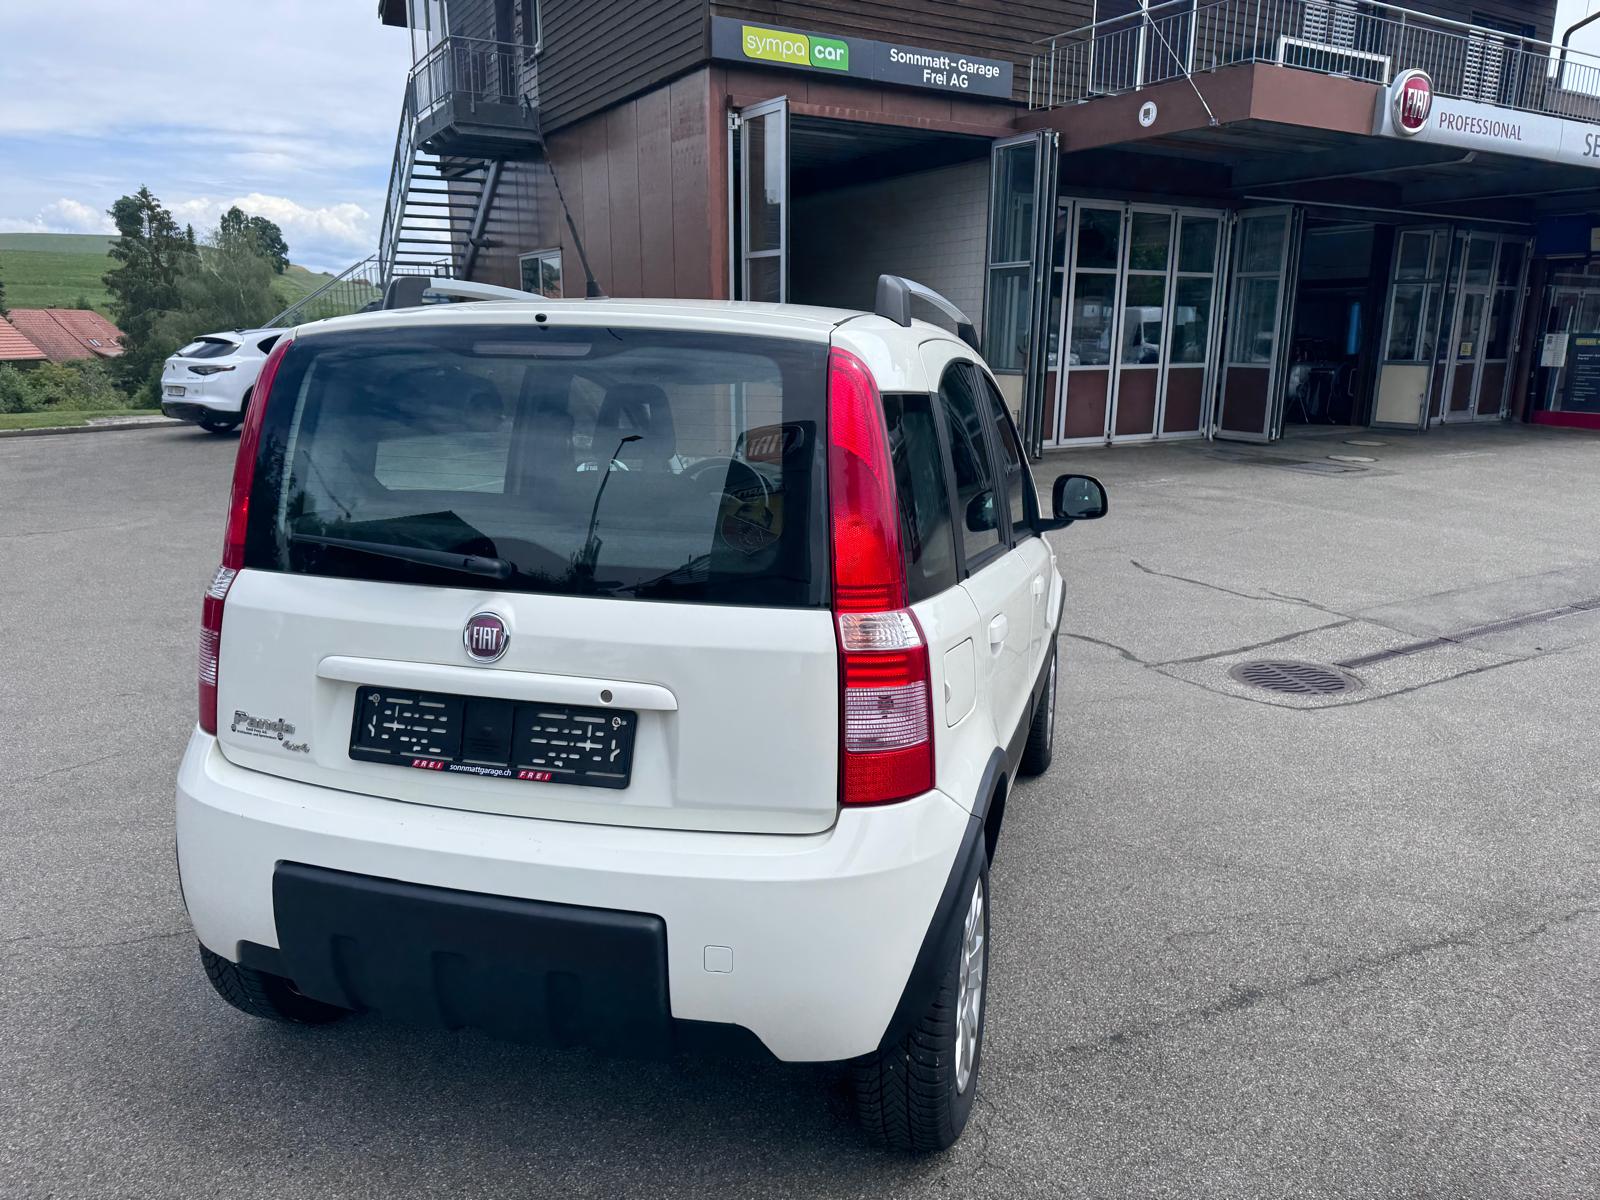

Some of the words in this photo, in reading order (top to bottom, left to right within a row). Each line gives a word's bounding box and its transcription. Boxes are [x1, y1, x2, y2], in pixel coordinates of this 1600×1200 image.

[747, 34, 806, 59] sympa
[814, 43, 845, 61] car
[889, 48, 1000, 78] Sonnmatt-Garage
[923, 69, 947, 86] Frei
[950, 73, 969, 89] AG
[1404, 87, 1430, 120] FIAT
[1439, 112, 1522, 141] PROFESSIONAL
[472, 626, 500, 650] FIAT
[412, 759, 443, 770] FREI
[449, 764, 512, 777] sonnmattgarage.ch
[519, 771, 550, 781] FREI
